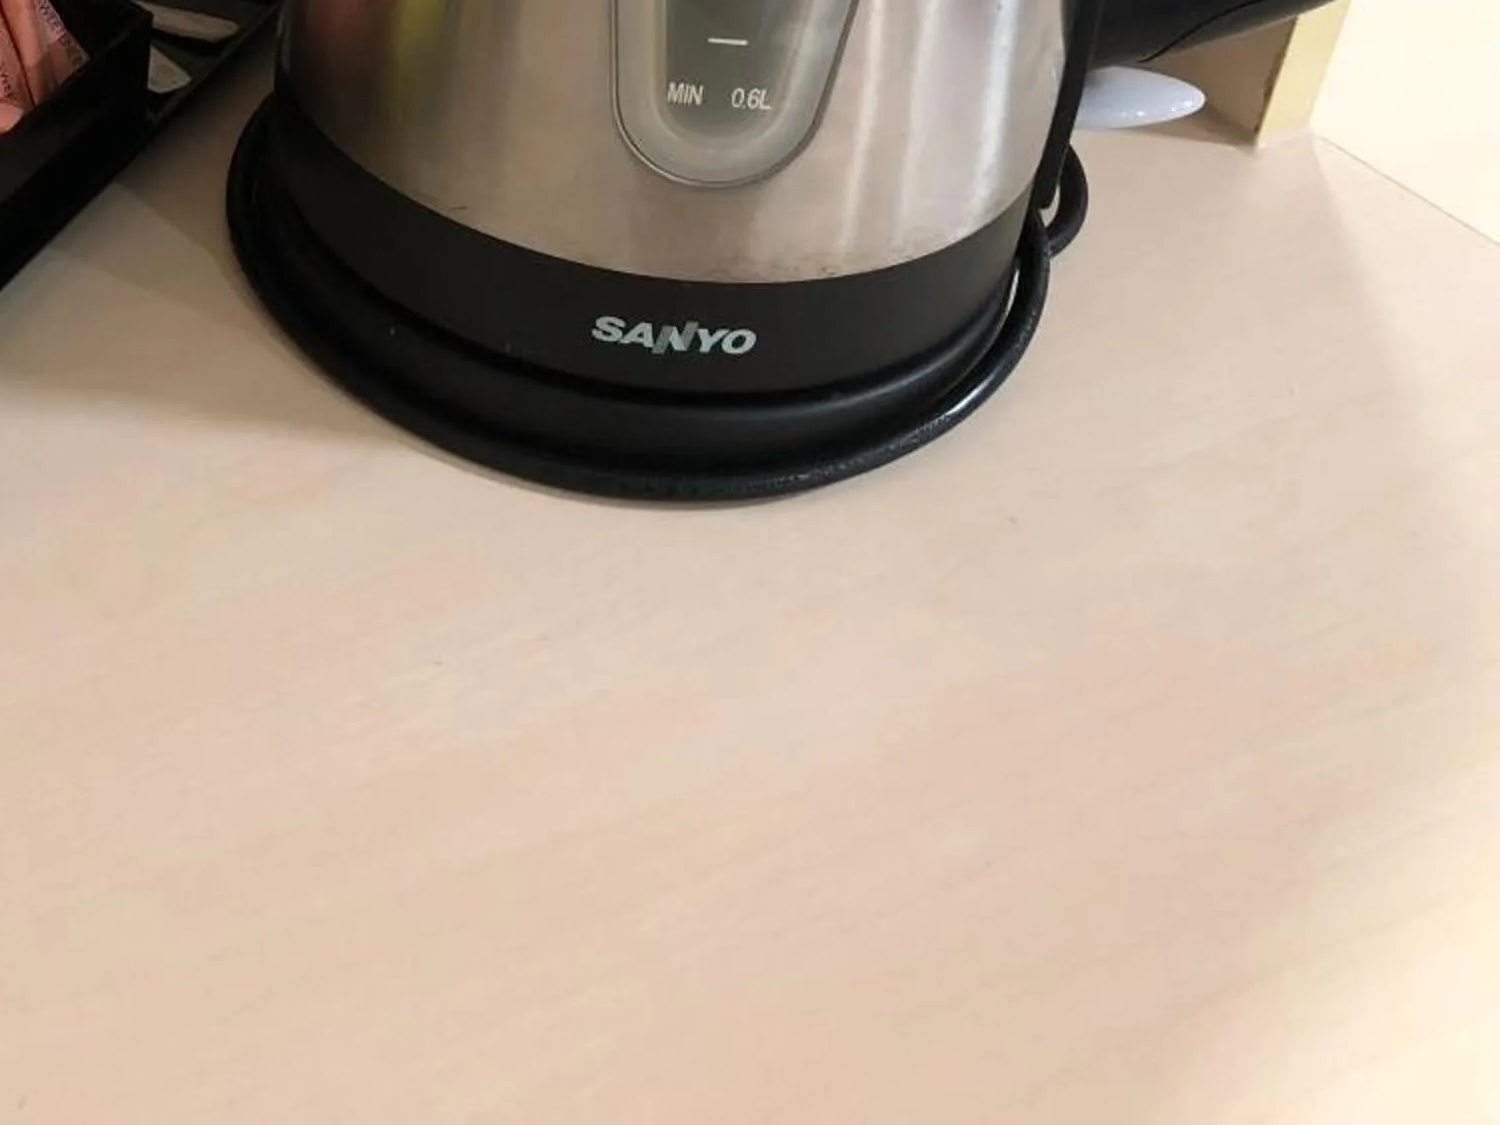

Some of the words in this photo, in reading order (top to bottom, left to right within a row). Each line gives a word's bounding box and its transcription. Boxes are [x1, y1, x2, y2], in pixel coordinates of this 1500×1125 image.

[667, 82, 704, 105] MIN
[731, 88, 773, 110] 0.6L
[591, 316, 757, 355] SANYO
